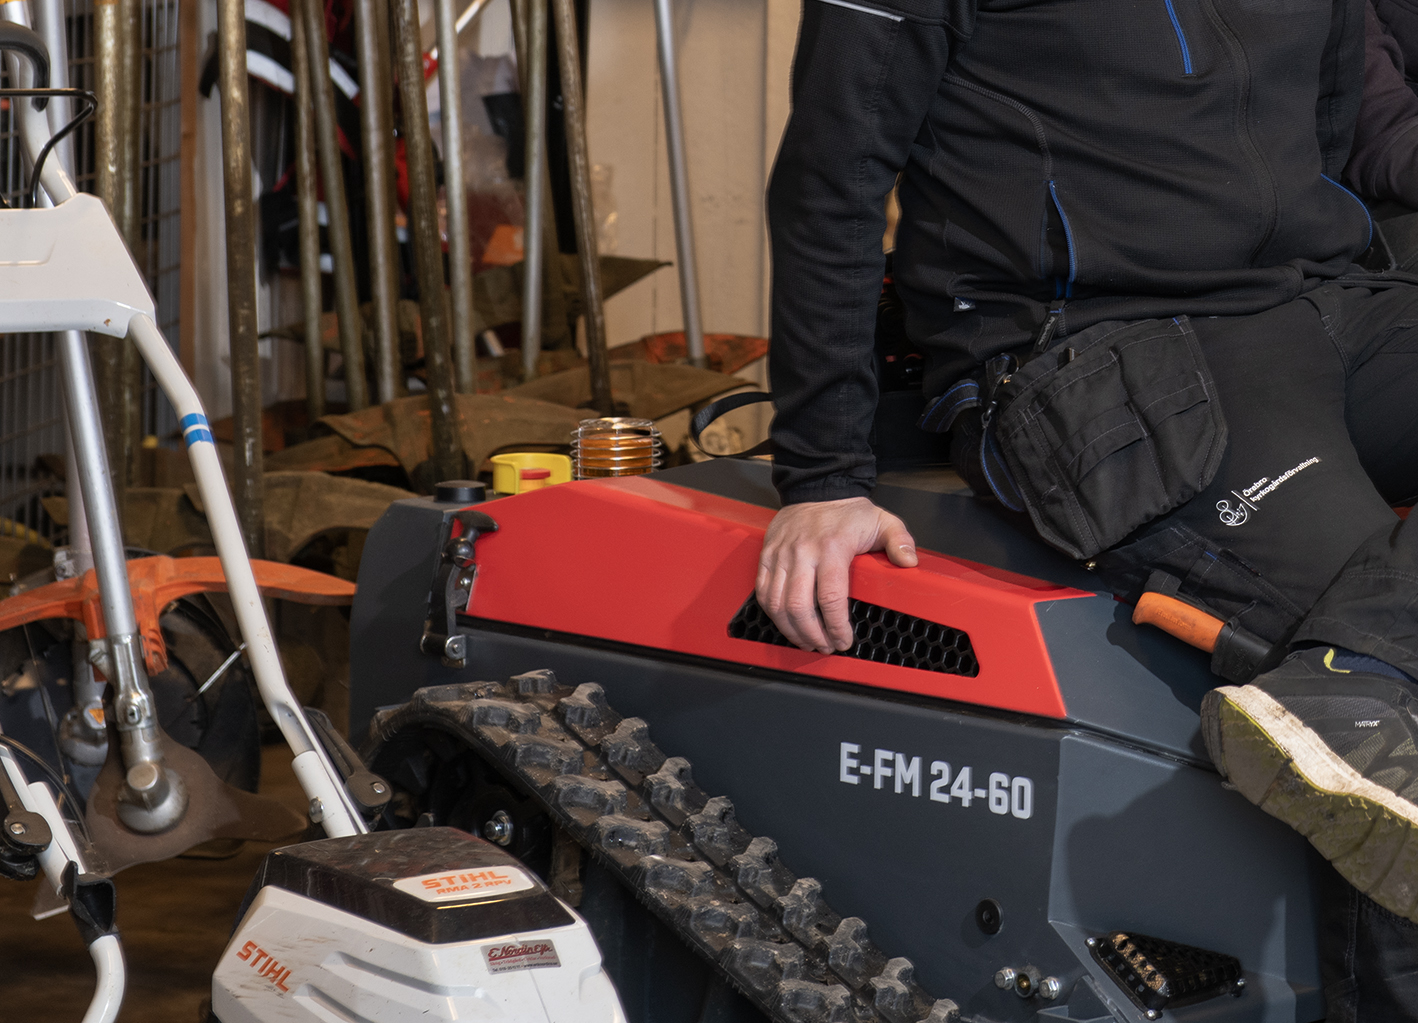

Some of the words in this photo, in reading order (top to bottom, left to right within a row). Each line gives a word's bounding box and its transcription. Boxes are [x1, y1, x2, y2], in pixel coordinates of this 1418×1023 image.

[1242, 477, 1267, 497] Örebro
[840, 742, 922, 798] E-FM
[930, 760, 1034, 820] 24-60
[421, 871, 508, 890] STIHL
[436, 884, 470, 895] RMA
[484, 879, 513, 888] RPV
[236, 940, 292, 994] STIHL
